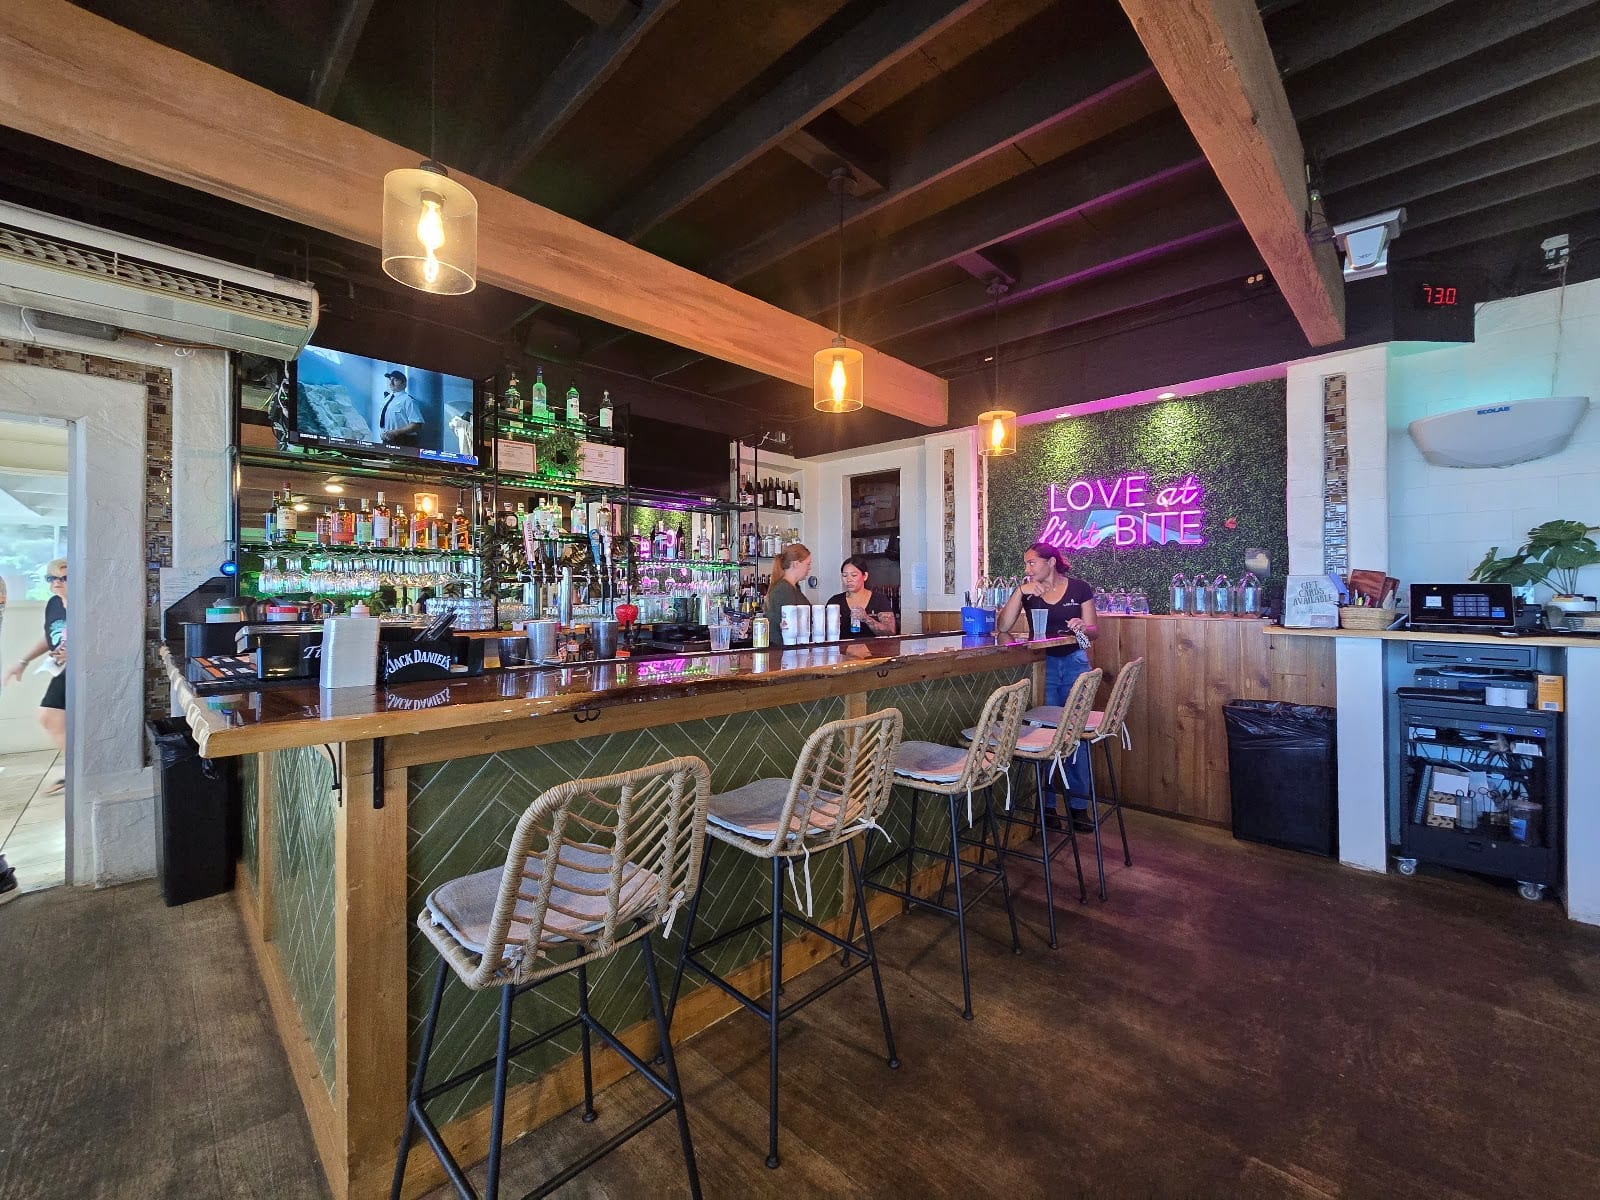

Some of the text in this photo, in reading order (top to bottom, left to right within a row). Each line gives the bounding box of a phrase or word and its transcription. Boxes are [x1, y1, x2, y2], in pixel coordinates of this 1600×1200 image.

[1050, 475, 1199, 513] LOVE at
[1115, 510, 1203, 546] BITE
[1293, 593, 1334, 607] AVAILABLE
[387, 652, 415, 674] JACK
